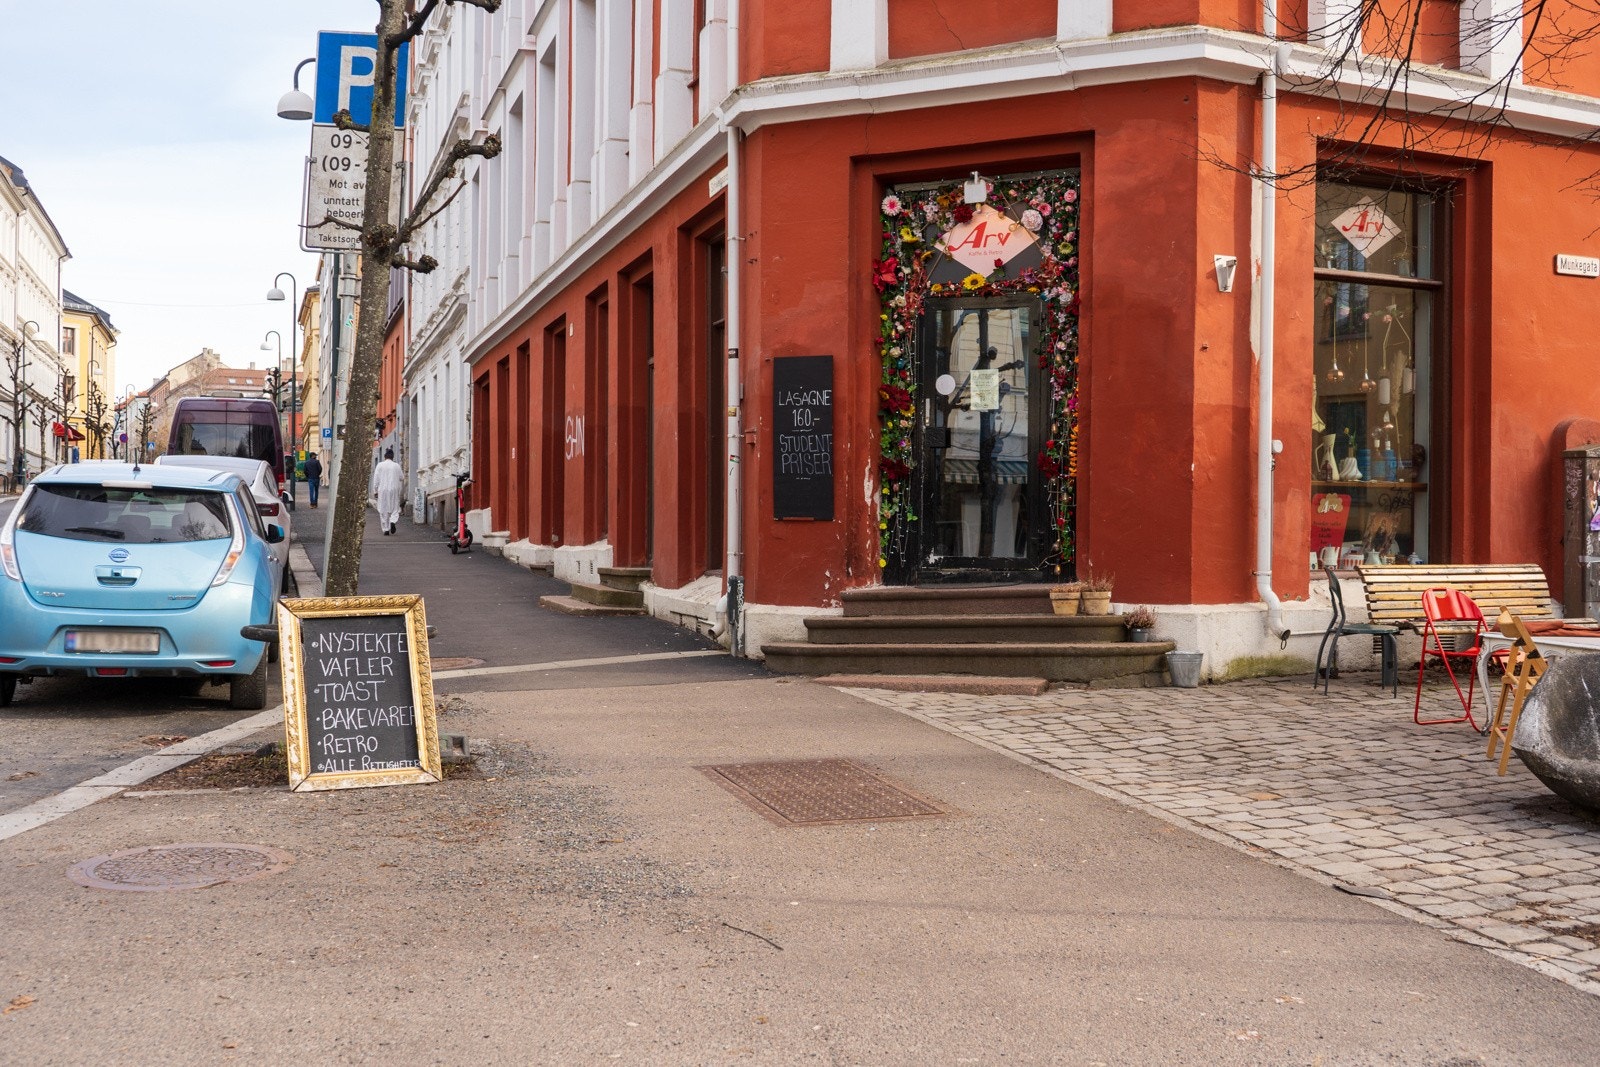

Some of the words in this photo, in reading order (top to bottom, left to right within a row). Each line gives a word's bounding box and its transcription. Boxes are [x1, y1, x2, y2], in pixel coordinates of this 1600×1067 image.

[337, 45, 377, 111] P
[329, 179, 347, 189] Mot
[323, 197, 360, 206] unntatt
[1342, 209, 1384, 232] Arv
[947, 221, 1011, 252] Arv
[1560, 257, 1598, 274] Munkegata
[778, 390, 832, 406] LASAGNE
[781, 452, 832, 474] PRISER
[319, 632, 408, 654] NYSTEKTE
[319, 656, 394, 677] VAFLER
[317, 680, 386, 702] TOAST
[323, 733, 378, 755] RETRO
[324, 758, 356, 773] ALLE
